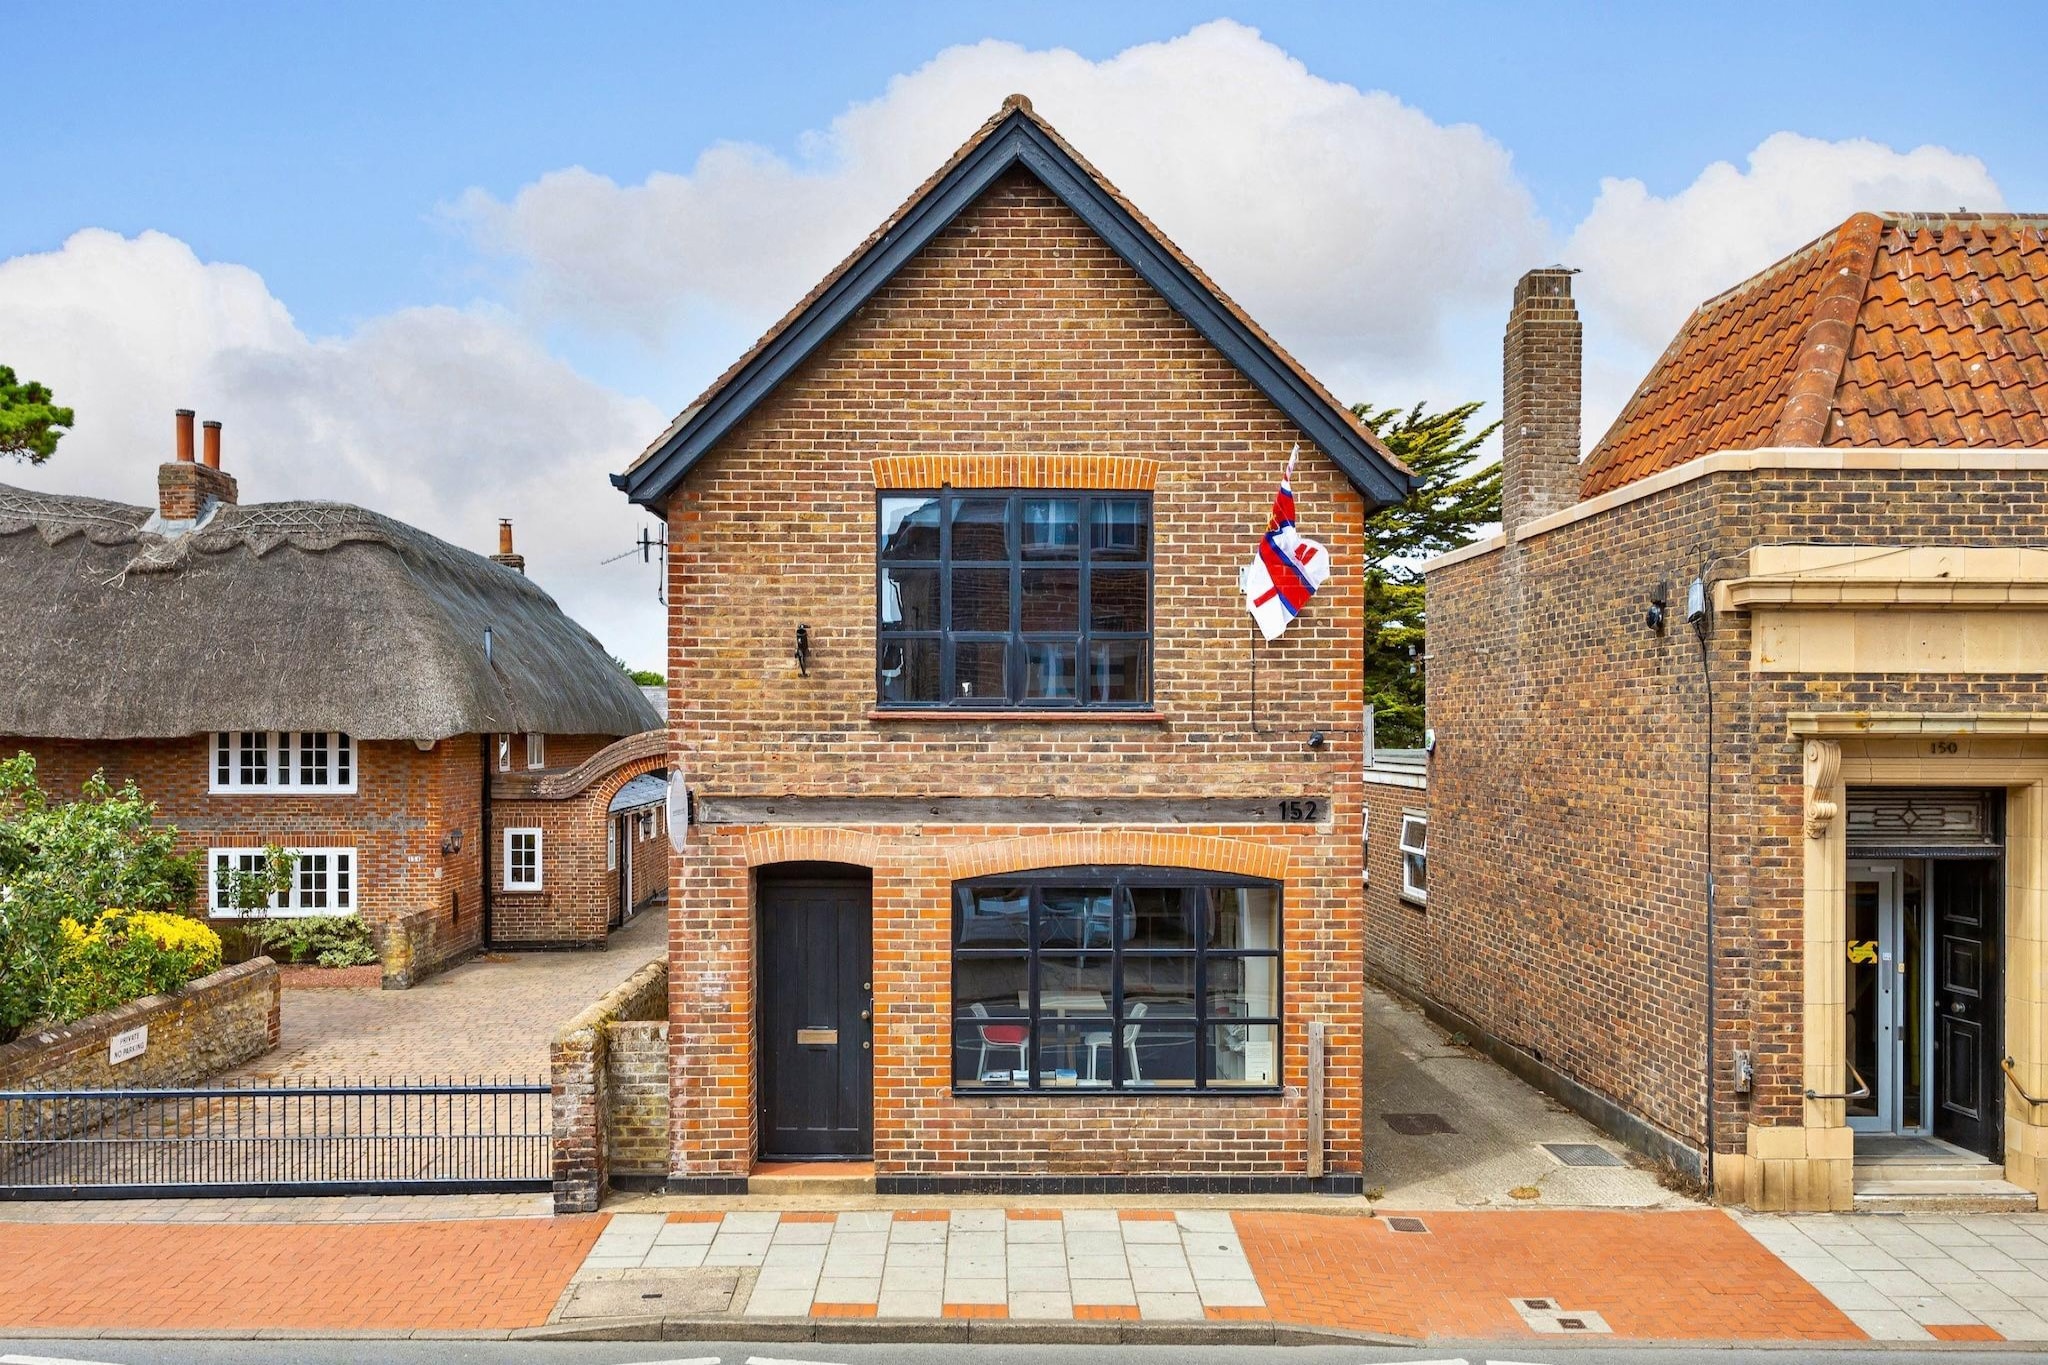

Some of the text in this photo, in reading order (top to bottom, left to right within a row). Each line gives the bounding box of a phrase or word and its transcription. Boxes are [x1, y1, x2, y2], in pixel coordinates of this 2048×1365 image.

[1930, 741, 1958, 754] 150
[1278, 801, 1317, 820] 152
[119, 1033, 140, 1045] PRIVATE
[114, 1042, 144, 1059] NO PARKING
